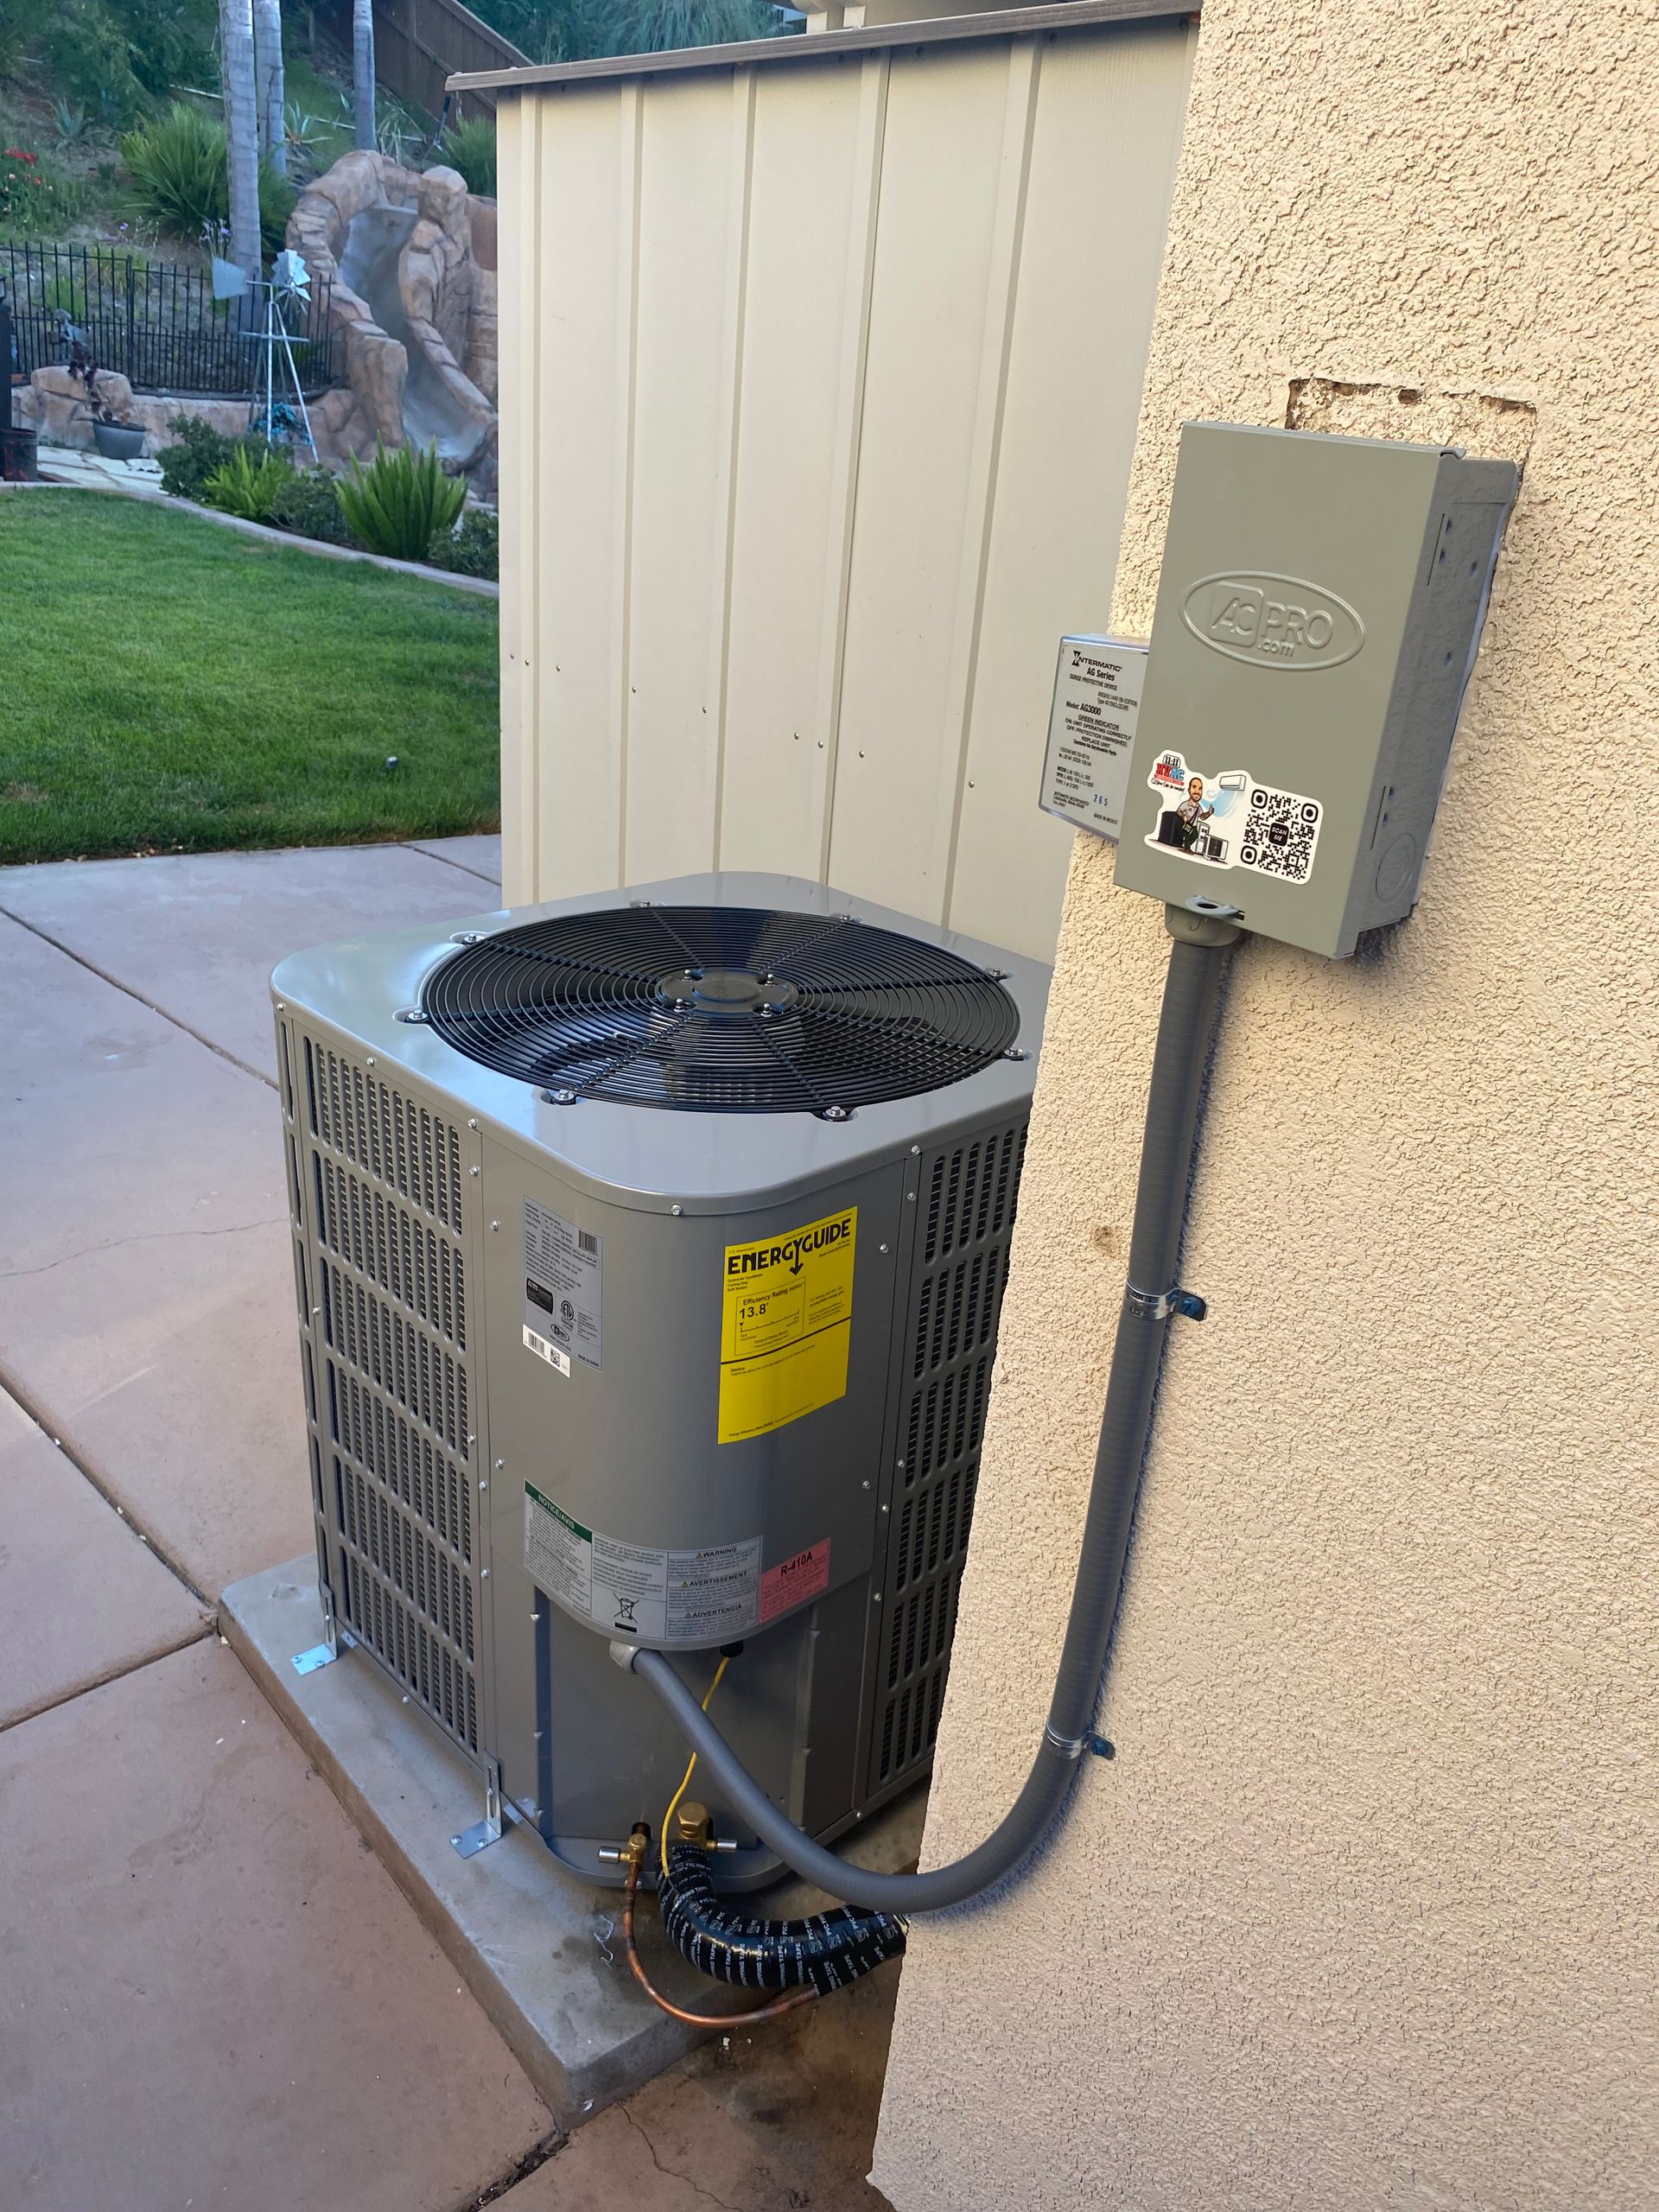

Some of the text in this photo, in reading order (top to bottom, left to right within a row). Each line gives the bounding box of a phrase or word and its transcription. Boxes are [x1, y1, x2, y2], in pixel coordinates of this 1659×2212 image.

[1258, 639, 1294, 658] .com
[1069, 673, 1081, 682] SURGE
[1082, 677, 1103, 688] PROTECTIVE
[1086, 667, 1115, 681] AG Series
[1065, 701, 1102, 715] Model: AG3000
[1078, 715, 1119, 731] GREEN INDICATOR
[1076, 728, 1102, 740] PROTECTION
[1083, 722, 1106, 734] OPERATING
[1106, 729, 1132, 741] CORRECTLY
[1081, 736, 1100, 746] REPLACE
[1155, 762, 1185, 781] HVAC
[1271, 826, 1287, 836] SCAN
[728, 1217, 851, 1275] ENERGYGUIDE
[743, 1294, 771, 1305] Efficiency
[772, 1288, 789, 1298] Rating
[702, 1547, 737, 1557] WARNING
[780, 1551, 812, 1577] R-410A
[689, 1571, 747, 1586] AVERTISSEMENT
[692, 1604, 742, 1618] ADVERTENCIA
[849, 1917, 859, 1929] PVC
[876, 1914, 887, 1927] PVC
[806, 1928, 815, 1940] PVC
[823, 1923, 833, 1936] PVC
[843, 1953, 854, 1970] TAPE
